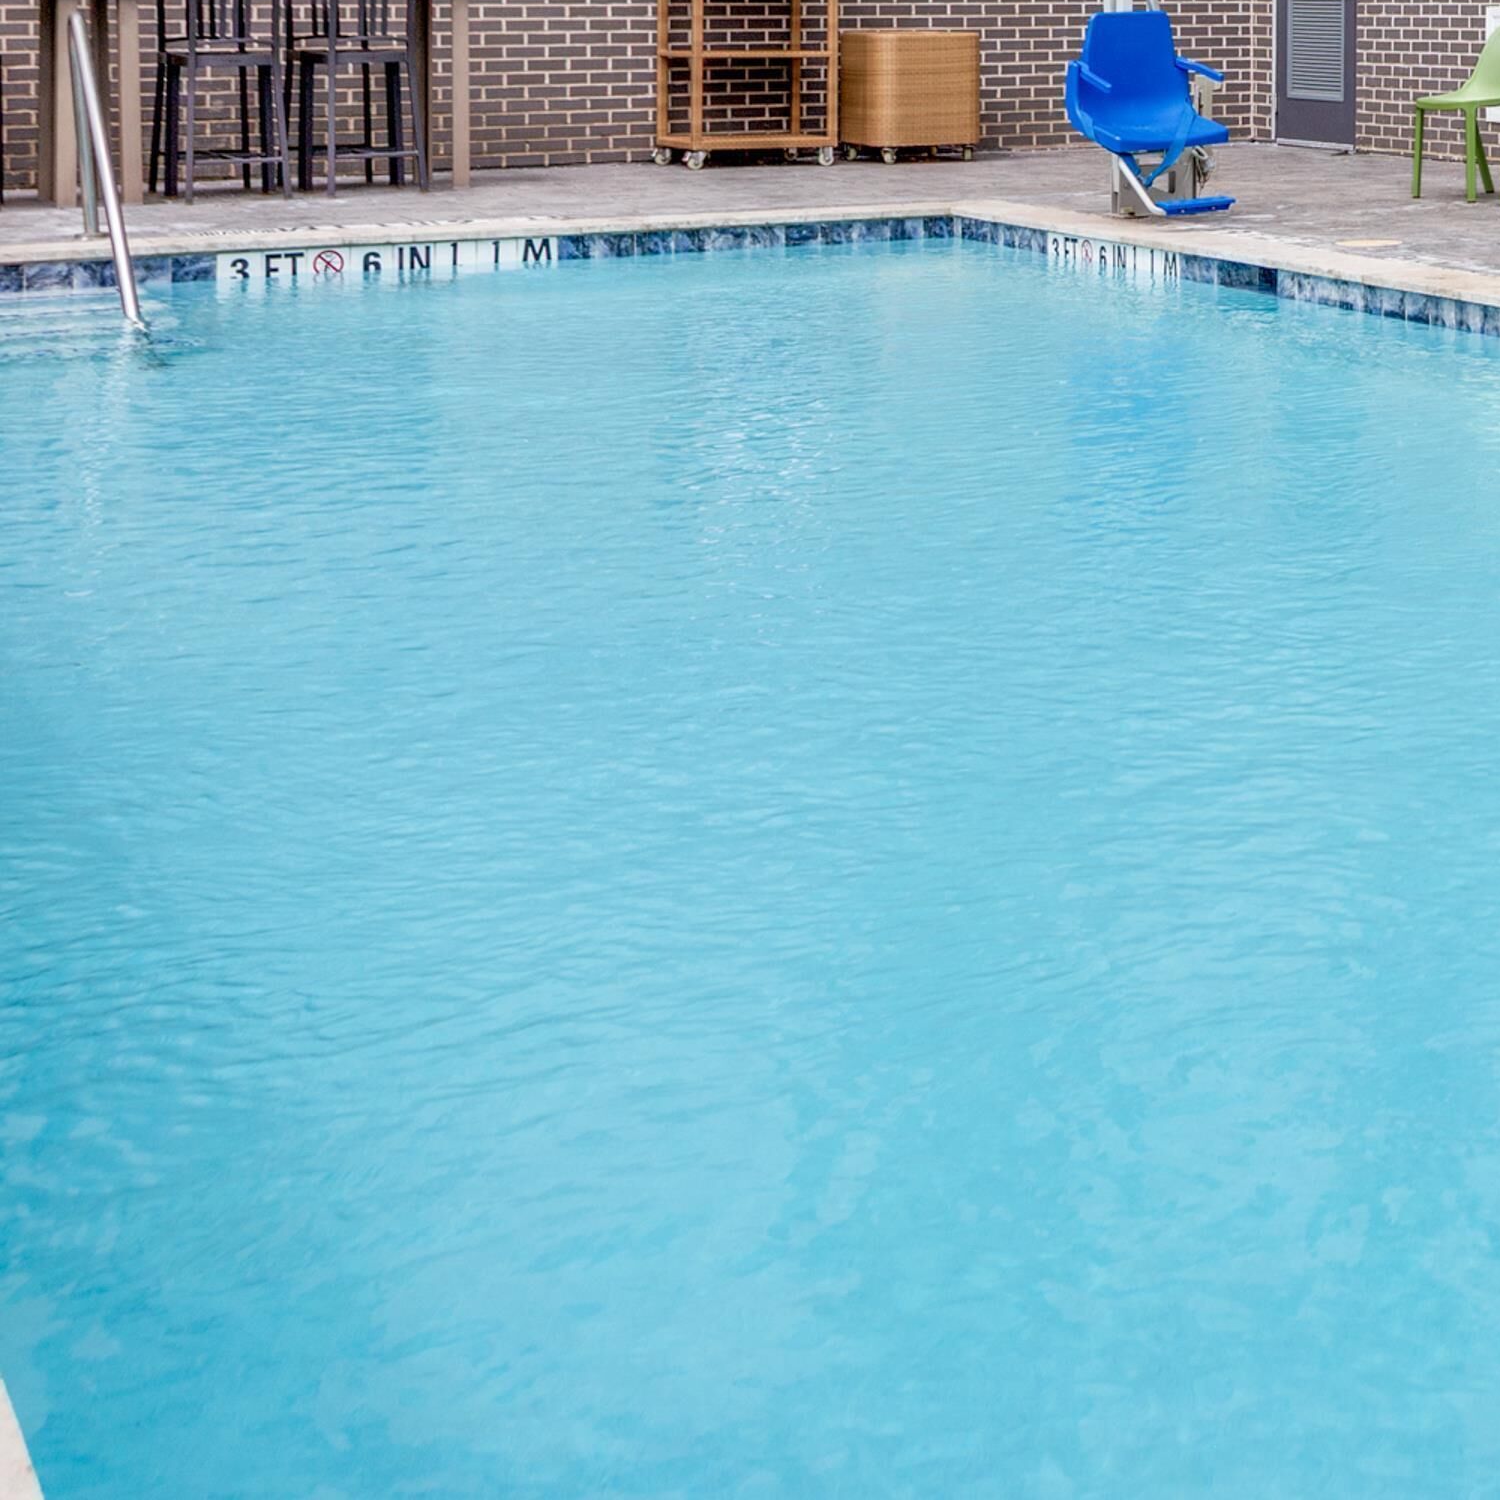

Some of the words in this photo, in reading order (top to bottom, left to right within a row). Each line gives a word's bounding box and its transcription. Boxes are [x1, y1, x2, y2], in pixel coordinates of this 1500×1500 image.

[230, 258, 250, 278] 3
[265, 252, 304, 278] FT
[363, 251, 381, 272] 6
[398, 245, 431, 270] IN
[522, 238, 552, 262] M
[1052, 238, 1060, 257] 3
[1064, 237, 1078, 260] FT
[1100, 246, 1107, 263] 6
[1113, 244, 1127, 269] IN
[1163, 252, 1177, 277] M
